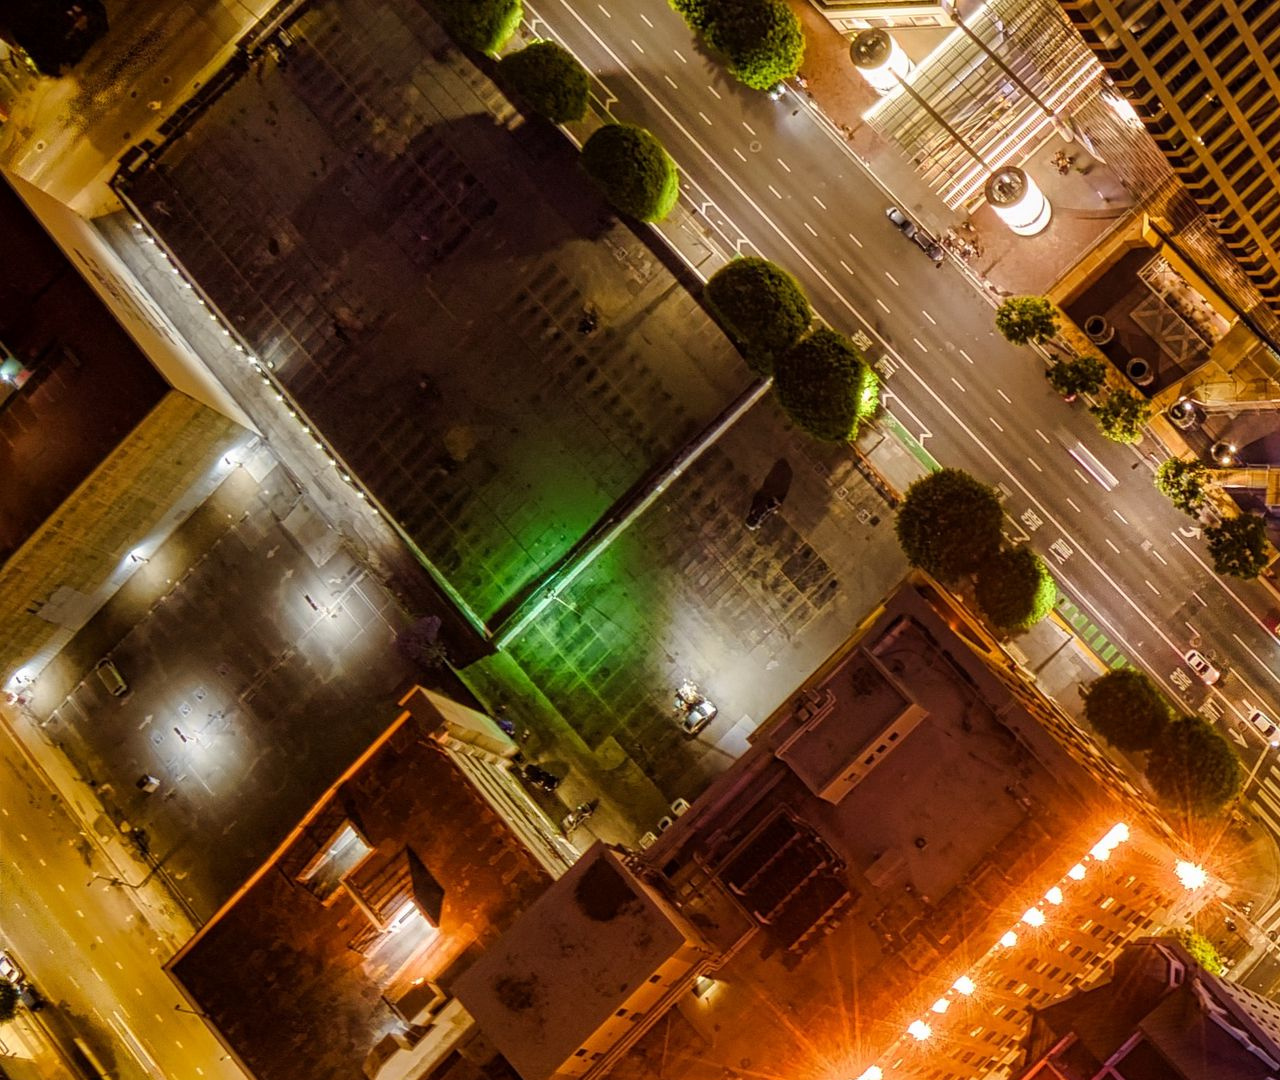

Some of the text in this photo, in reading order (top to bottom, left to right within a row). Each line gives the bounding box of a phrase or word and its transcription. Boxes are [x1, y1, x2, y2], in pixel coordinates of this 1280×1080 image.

[1020, 508, 1044, 532] BUS
[1048, 537, 1074, 565] ONLY
[1169, 667, 1193, 692] BUS
